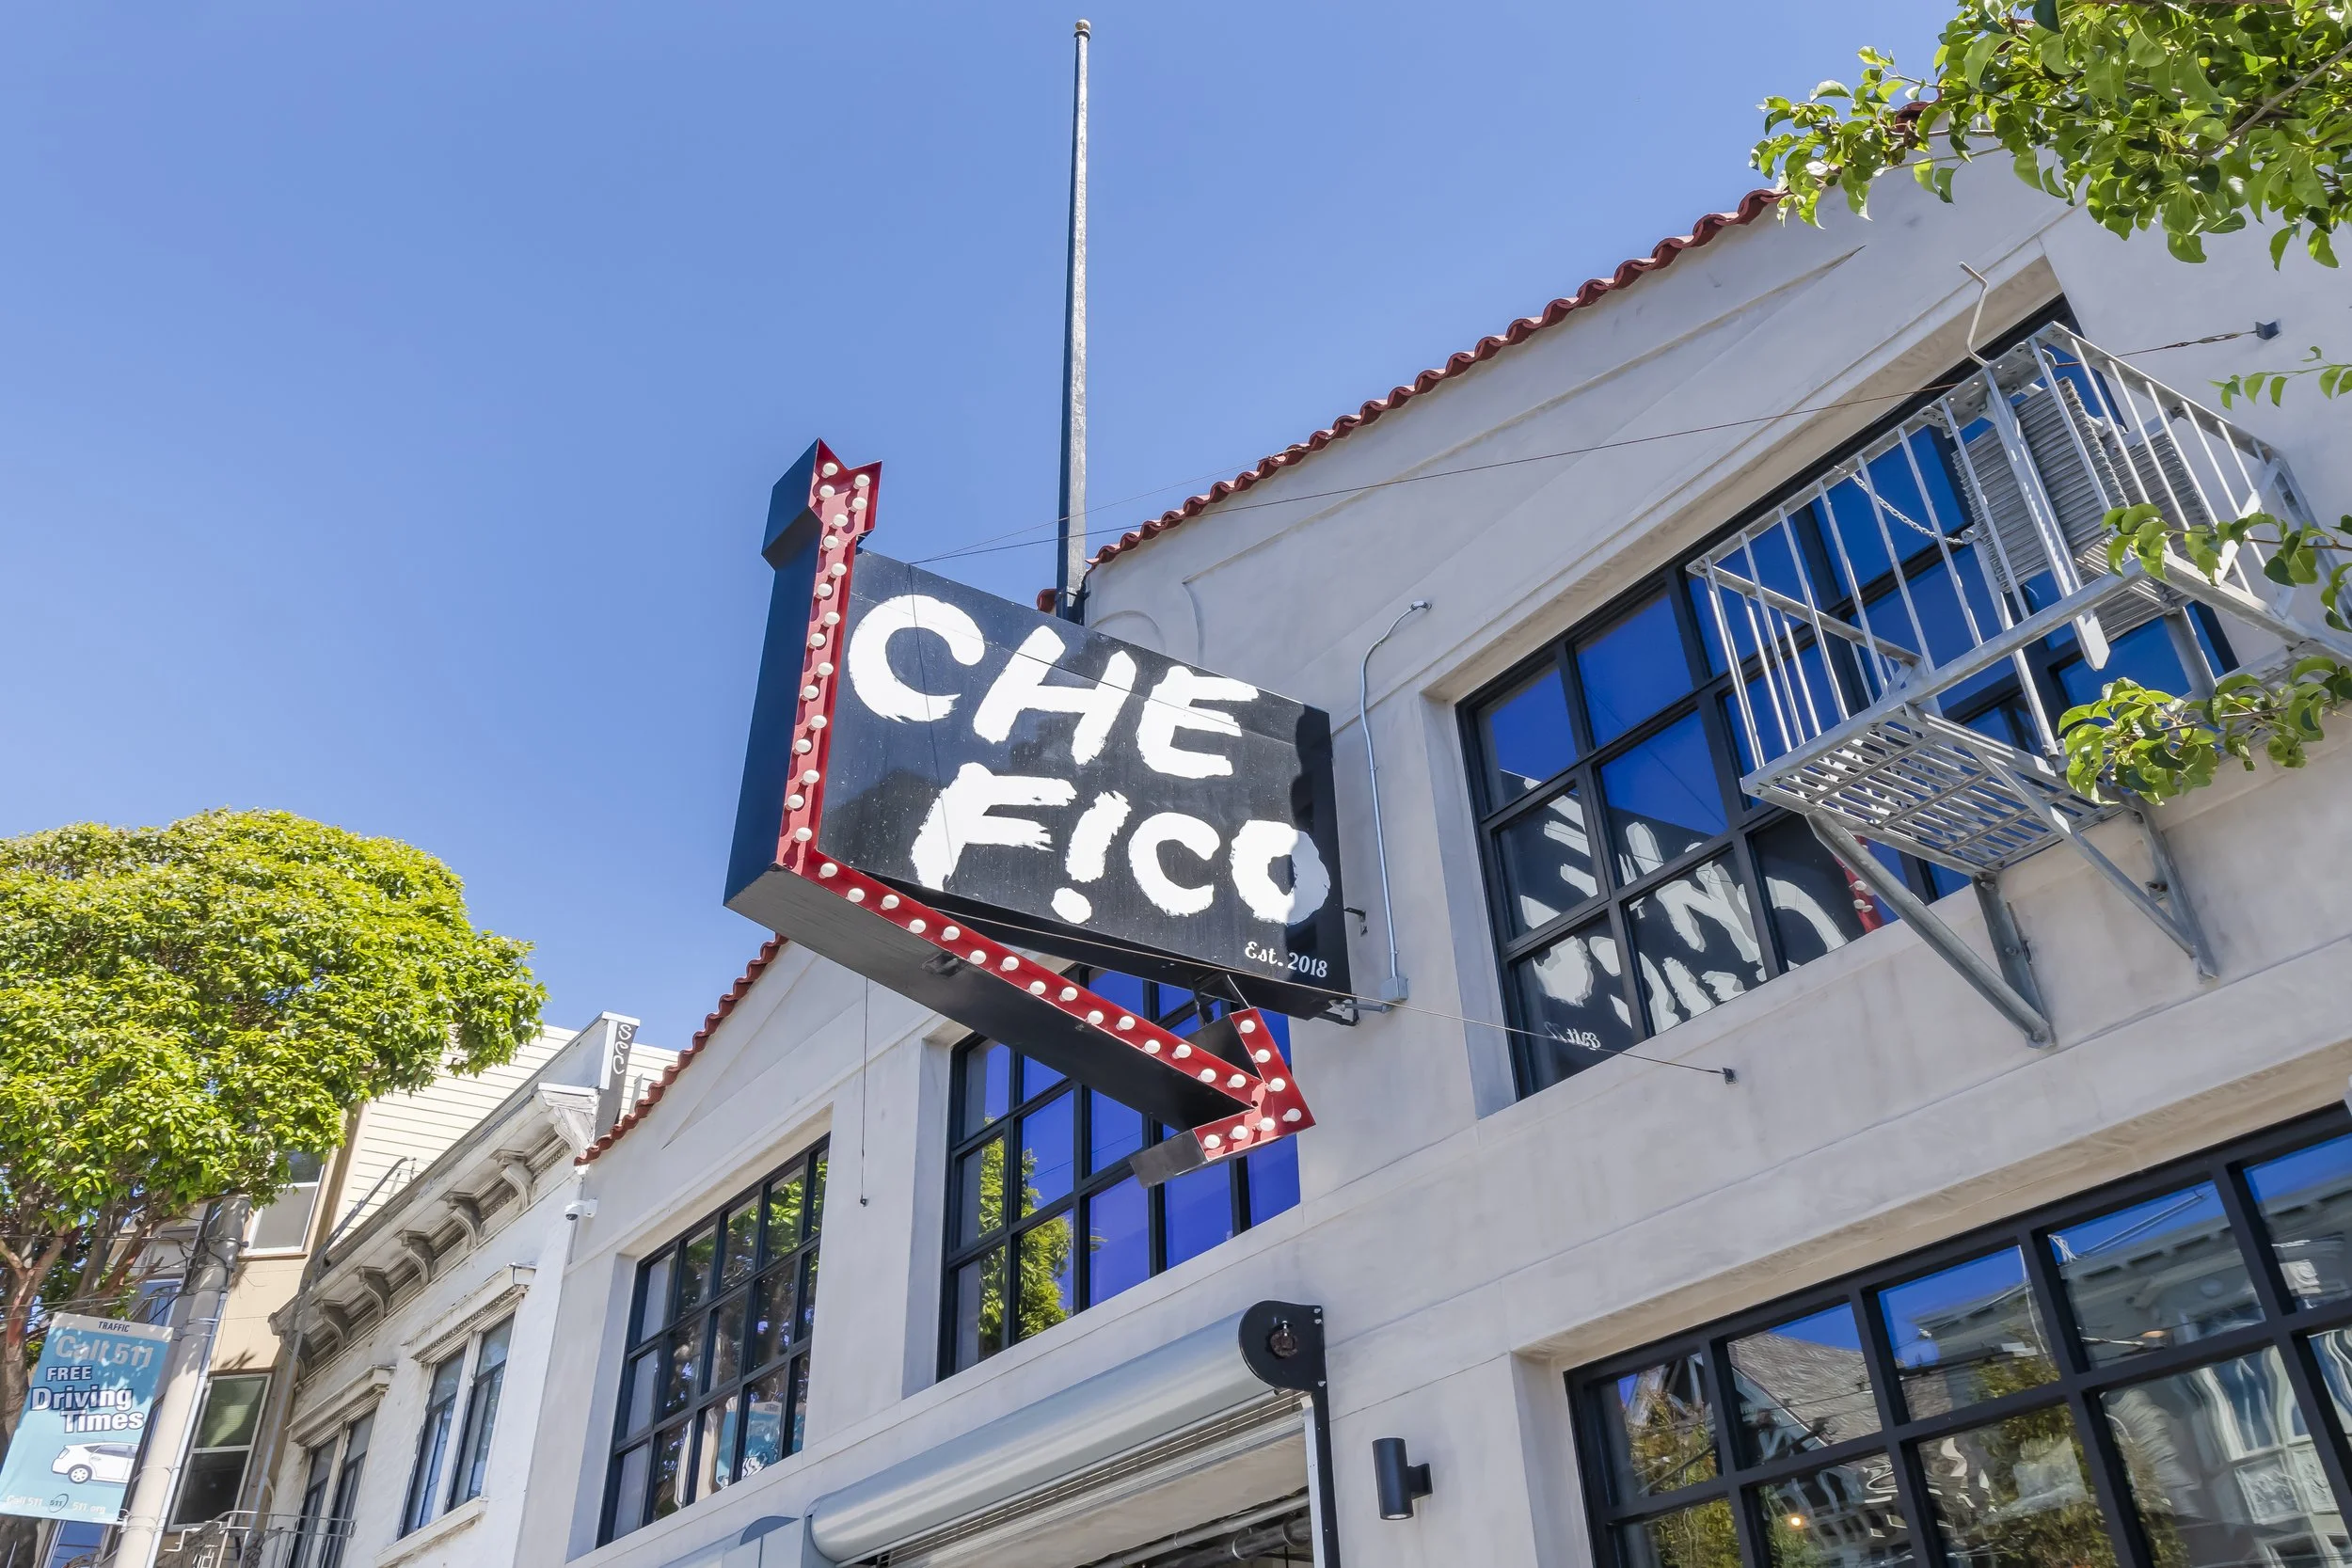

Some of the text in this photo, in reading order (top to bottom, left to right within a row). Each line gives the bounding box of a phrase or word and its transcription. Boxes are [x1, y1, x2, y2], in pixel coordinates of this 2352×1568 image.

[849, 594, 1259, 779] CHE
[1245, 942, 1327, 977] Est. 2018
[98, 1321, 130, 1333] TRAFFIC
[56, 1335, 153, 1368] Call 511
[46, 1366, 92, 1382] FREE
[30, 1385, 133, 1411] Driving
[60, 1411, 145, 1433] Times
